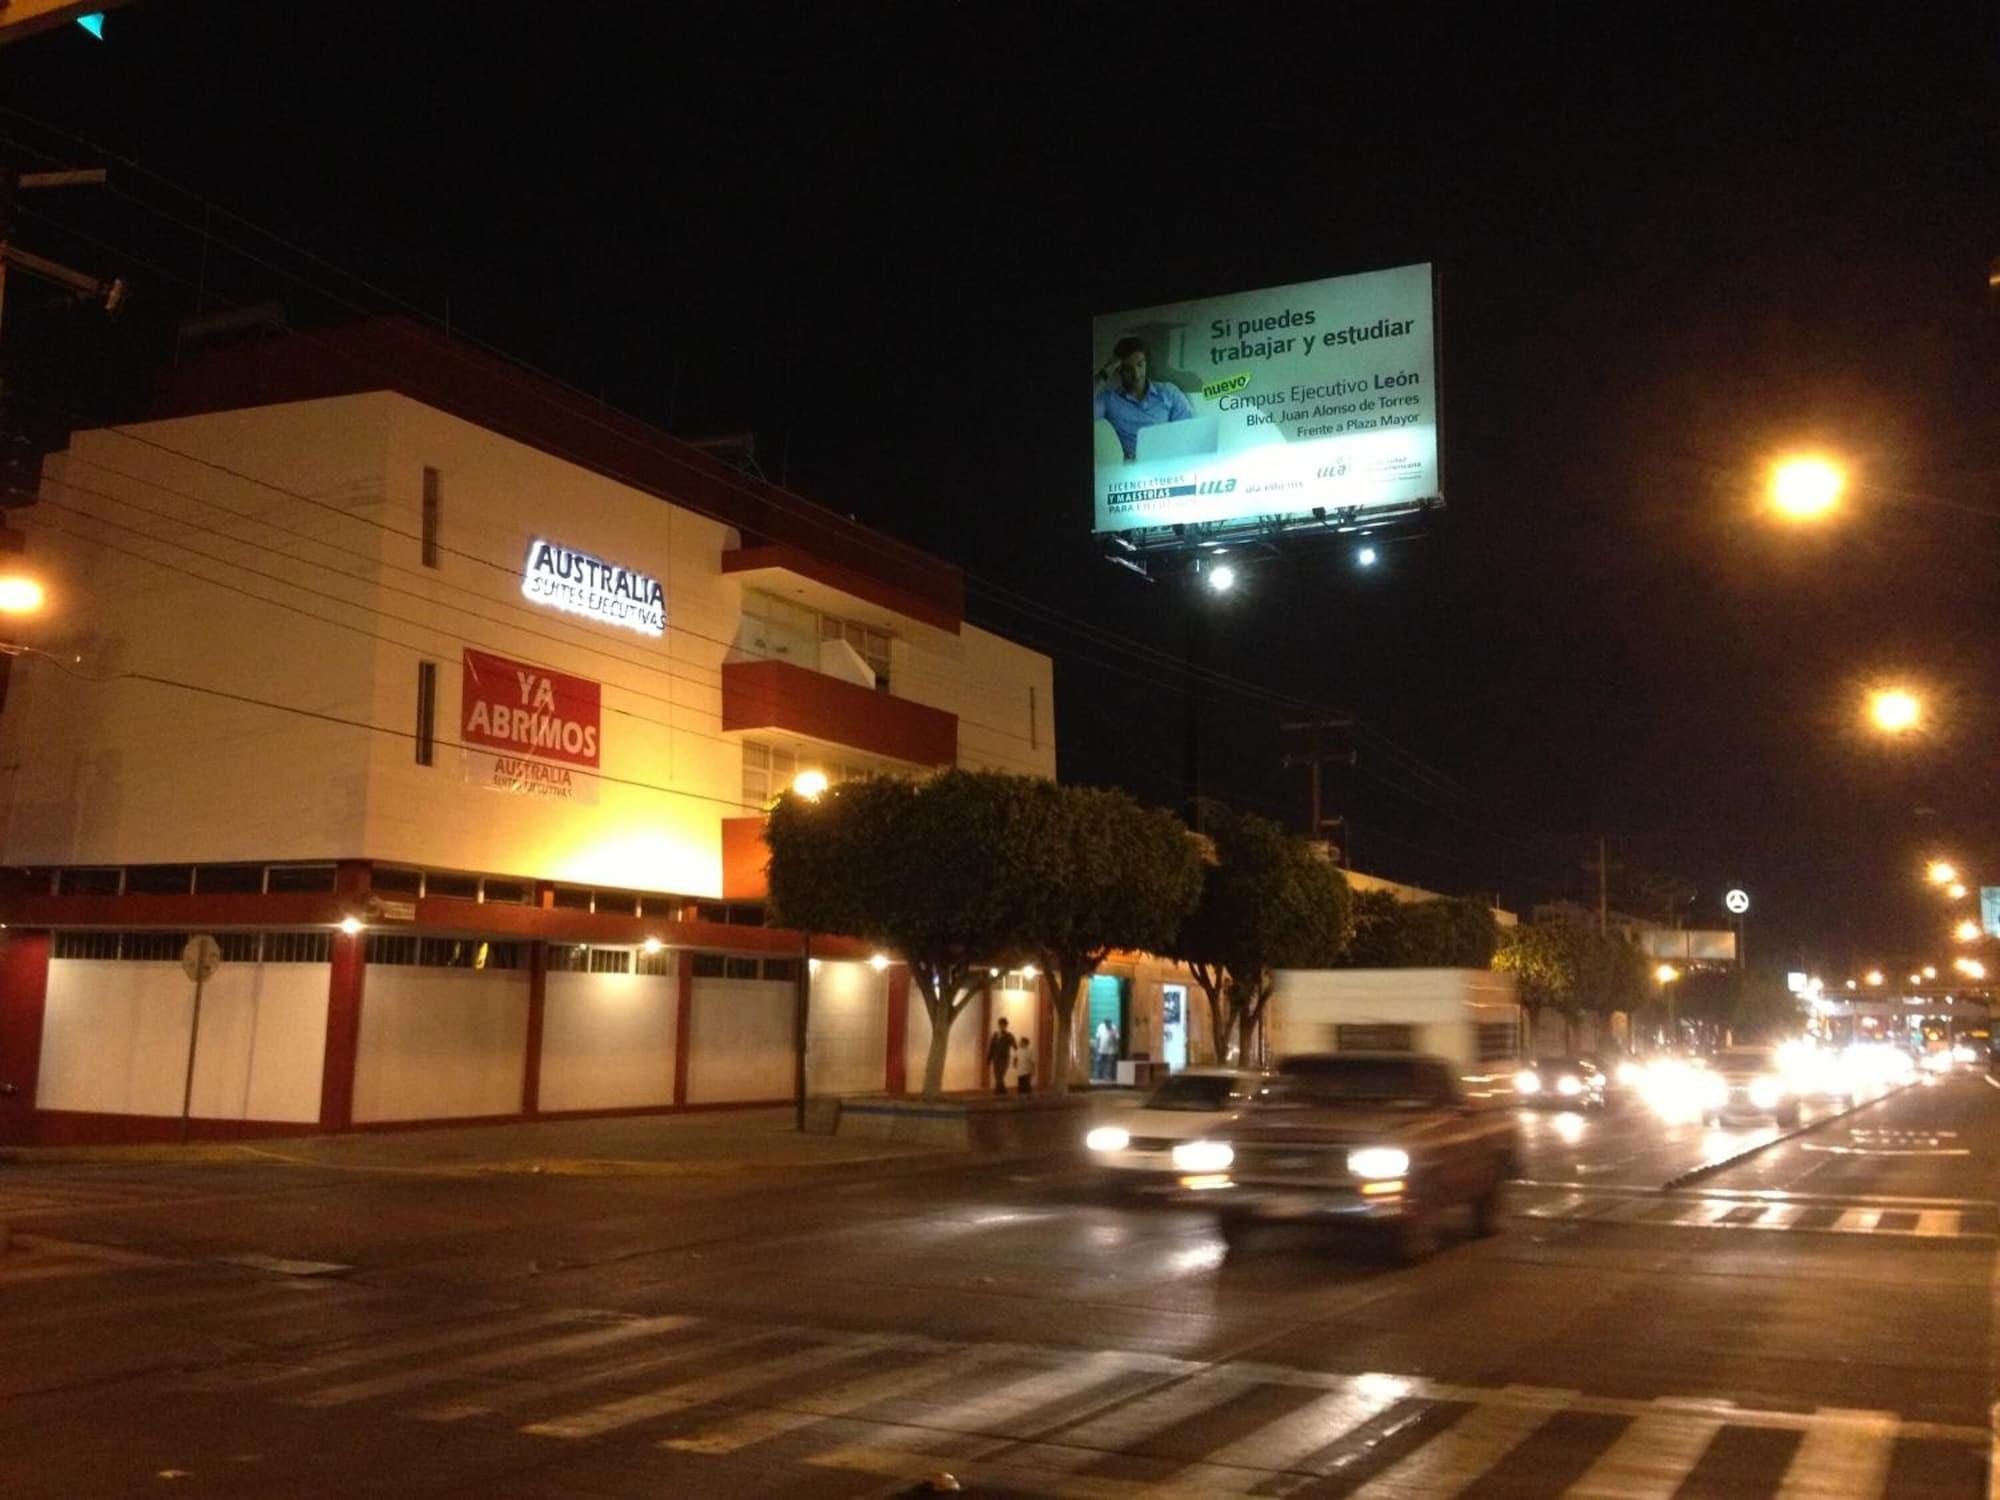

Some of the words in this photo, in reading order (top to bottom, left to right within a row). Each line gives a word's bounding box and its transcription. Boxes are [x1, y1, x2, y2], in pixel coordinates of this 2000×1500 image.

[1210, 336, 1296, 365] trabajar
[1303, 335, 1315, 356] y
[1323, 319, 1414, 346] estudiar
[1238, 309, 1316, 339] puedes
[1203, 375, 1246, 398] nuevo
[1219, 390, 1285, 412] Campus
[1291, 379, 1368, 404] Ejecutivo
[1374, 370, 1420, 390] León
[1279, 410, 1309, 424] Juan
[1312, 404, 1356, 418] Alonso
[1359, 398, 1376, 411] de
[1380, 394, 1420, 409] Torres
[1297, 425, 1334, 438] Frente
[1336, 423, 1344, 432] a
[1347, 417, 1377, 432] Plaza
[1380, 412, 1421, 429] Mayor
[534, 544, 666, 611] AUSTRALIA
[531, 576, 584, 607] SUITES
[588, 592, 668, 631] EJECUTIVAS
[516, 671, 556, 713] YA
[467, 699, 597, 758] ABRIMOS
[494, 757, 572, 787] AUSTRALIA
